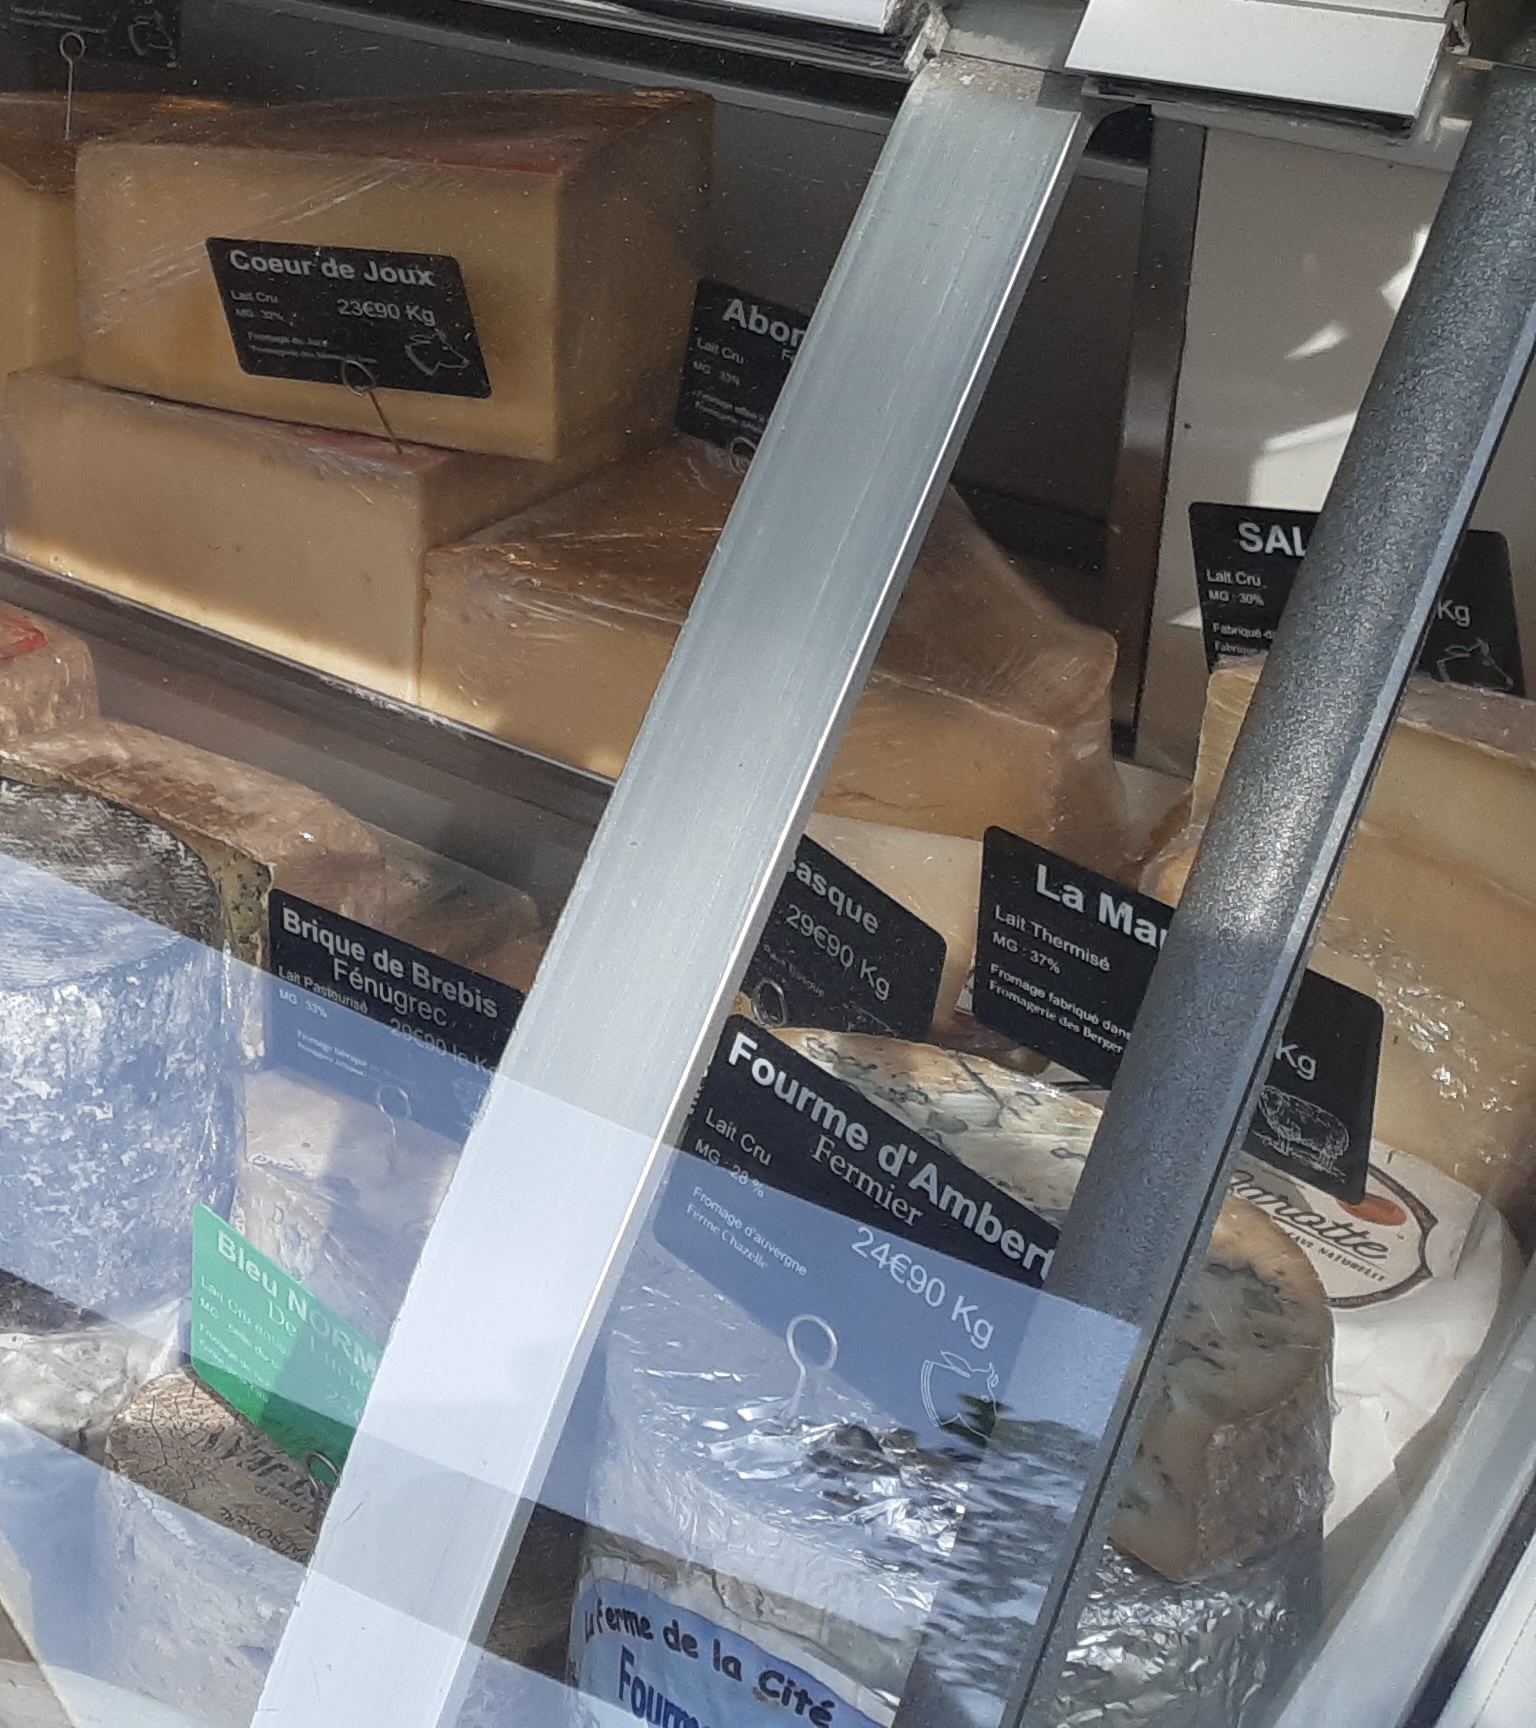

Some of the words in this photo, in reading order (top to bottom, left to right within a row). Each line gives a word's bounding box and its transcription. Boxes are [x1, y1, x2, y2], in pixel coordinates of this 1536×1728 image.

[229, 249, 313, 276] Coeur
[321, 259, 355, 280] de
[364, 262, 436, 287] Joux
[337, 299, 400, 320] 23€90
[405, 304, 435, 327] Kg
[1036, 864, 1085, 913] La
[282, 907, 365, 962] Brique
[373, 949, 404, 978] de
[413, 961, 498, 1019] Brebis
[994, 904, 1026, 930] Lait
[1031, 921, 1112, 972] Thermisé
[334, 958, 447, 1027] Fénugrec
[728, 1032, 869, 1152] Fourme
[878, 1143, 1056, 1281] d'Ambert
[811, 1135, 924, 1228] Fermier
[850, 1226, 946, 1307] 24€90
[951, 1295, 994, 1350] Kg
